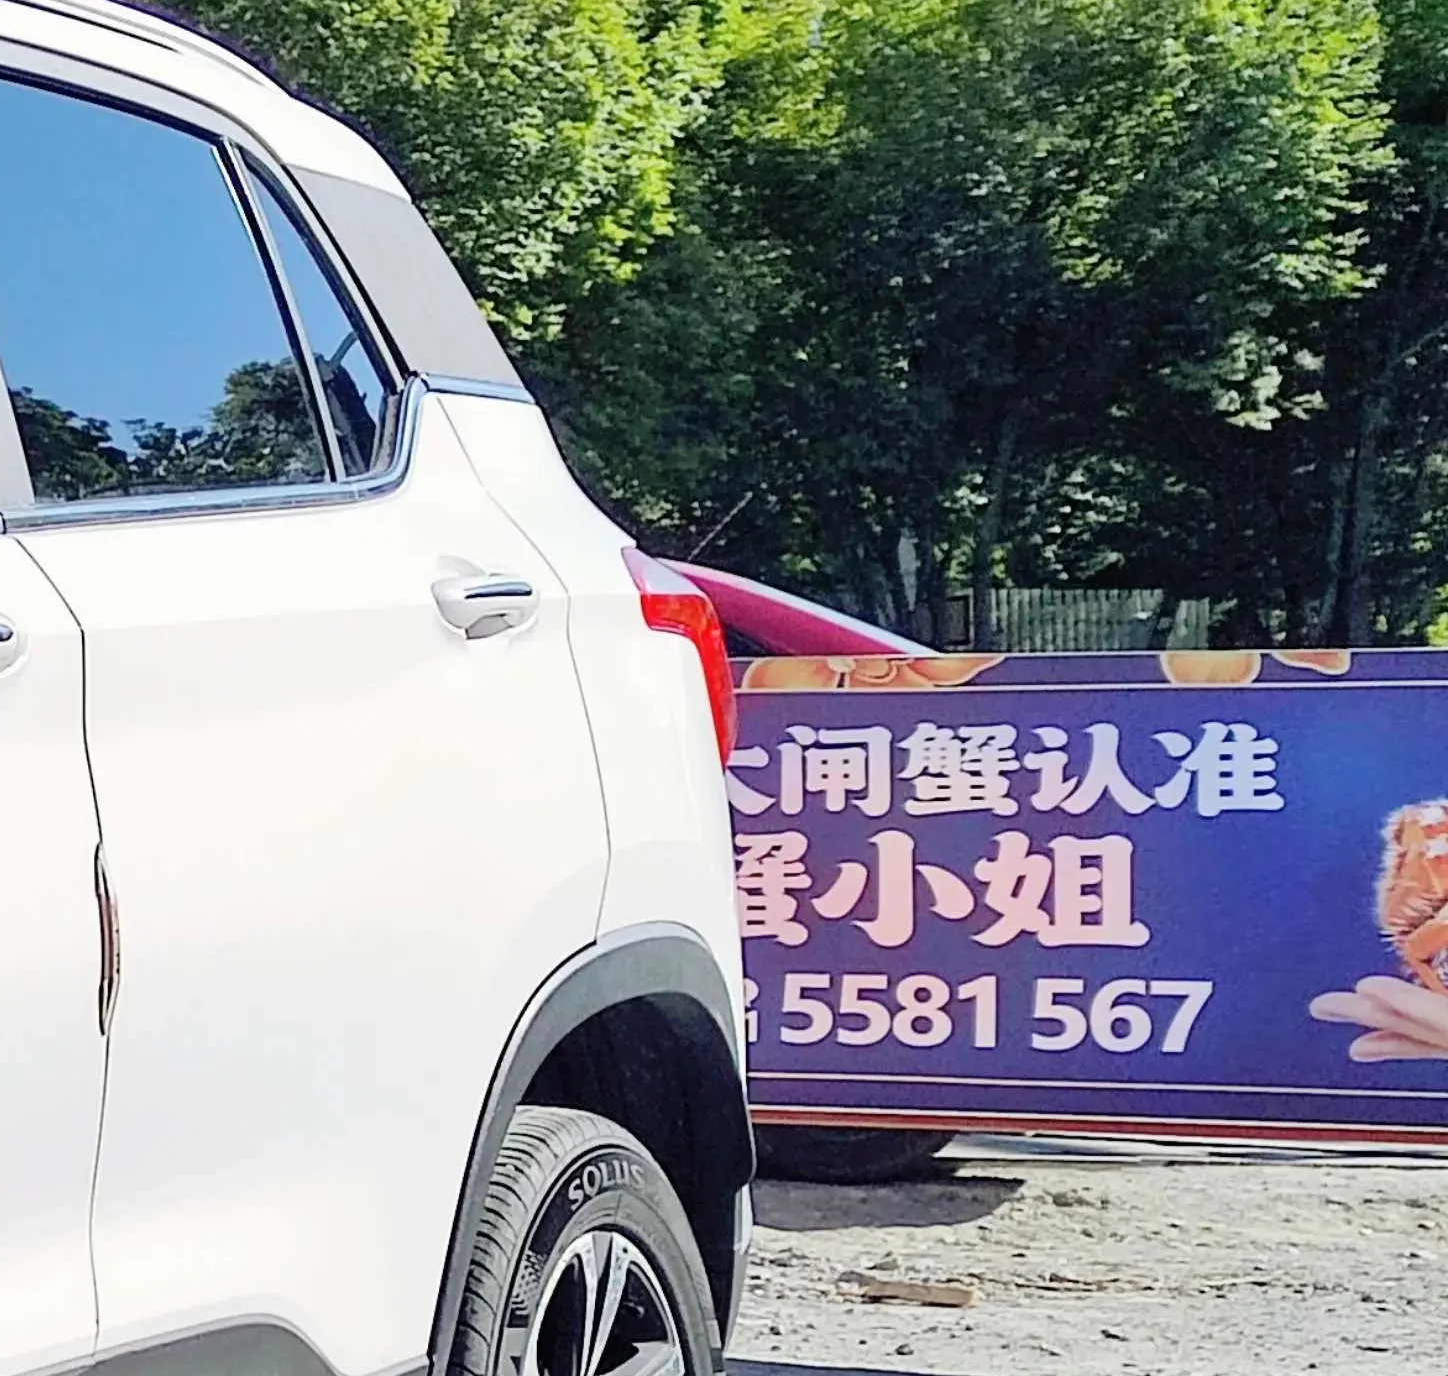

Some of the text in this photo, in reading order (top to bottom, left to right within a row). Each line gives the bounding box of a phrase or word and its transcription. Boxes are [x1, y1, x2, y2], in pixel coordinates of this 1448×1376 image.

[780, 973, 998, 1048] 5581
[1030, 978, 1214, 1053] 567
[567, 1159, 646, 1211] SOLUS
